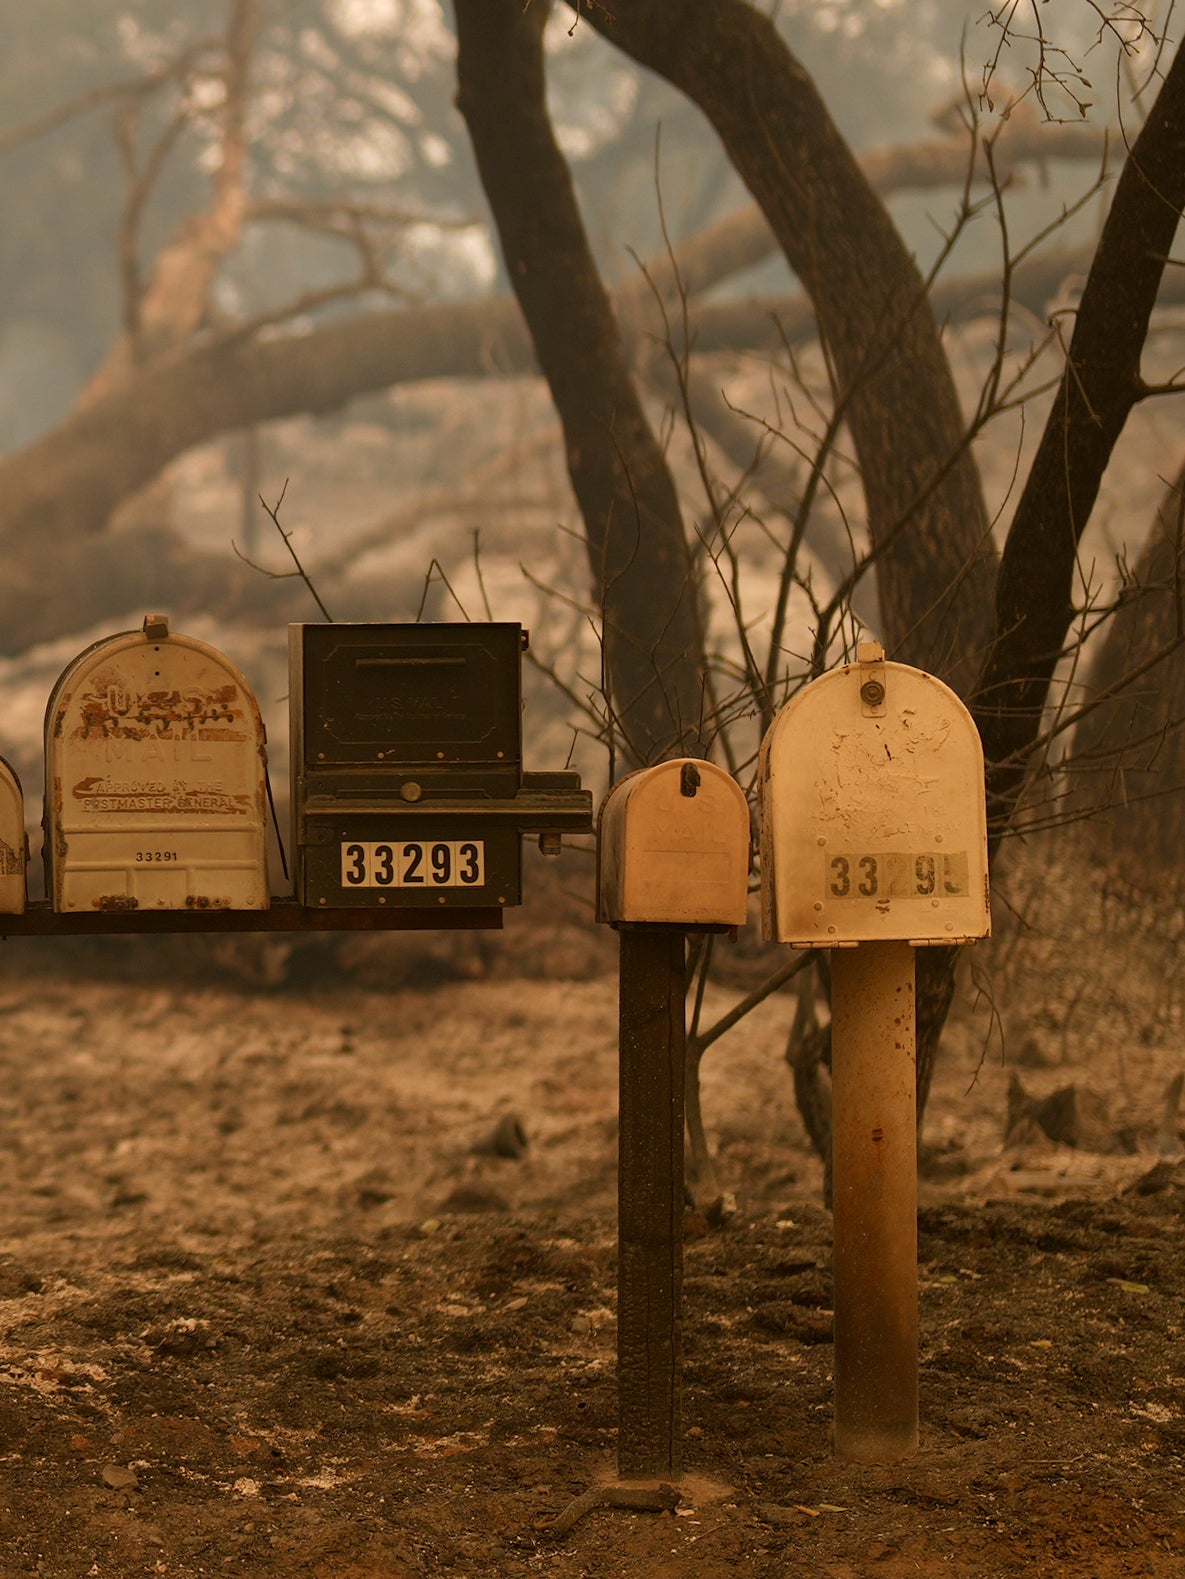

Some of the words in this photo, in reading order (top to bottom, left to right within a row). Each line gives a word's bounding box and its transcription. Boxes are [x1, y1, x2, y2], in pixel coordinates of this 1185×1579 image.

[95, 780, 166, 794] APPROVED
[82, 797, 171, 810] POSTMASTER
[135, 851, 178, 863] 33291
[346, 844, 479, 884] 33293
